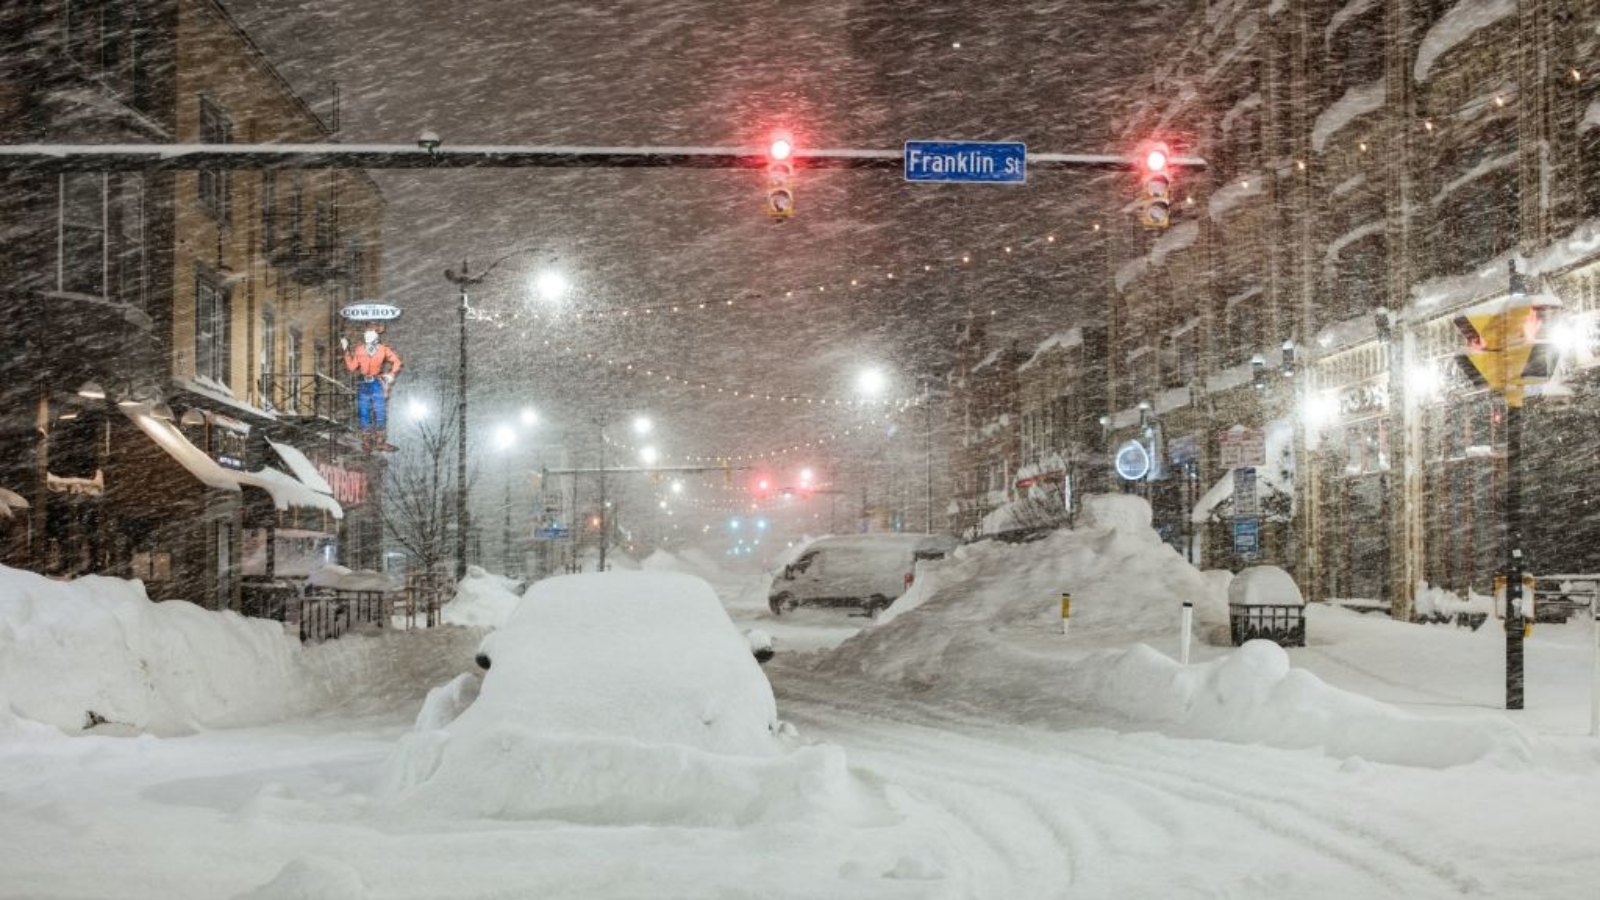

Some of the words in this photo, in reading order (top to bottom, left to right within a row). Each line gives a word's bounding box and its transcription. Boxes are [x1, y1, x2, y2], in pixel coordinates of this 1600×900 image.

[909, 150, 994, 173] Franklin
[1004, 157, 1021, 174] St
[343, 308, 396, 317] COWBOY
